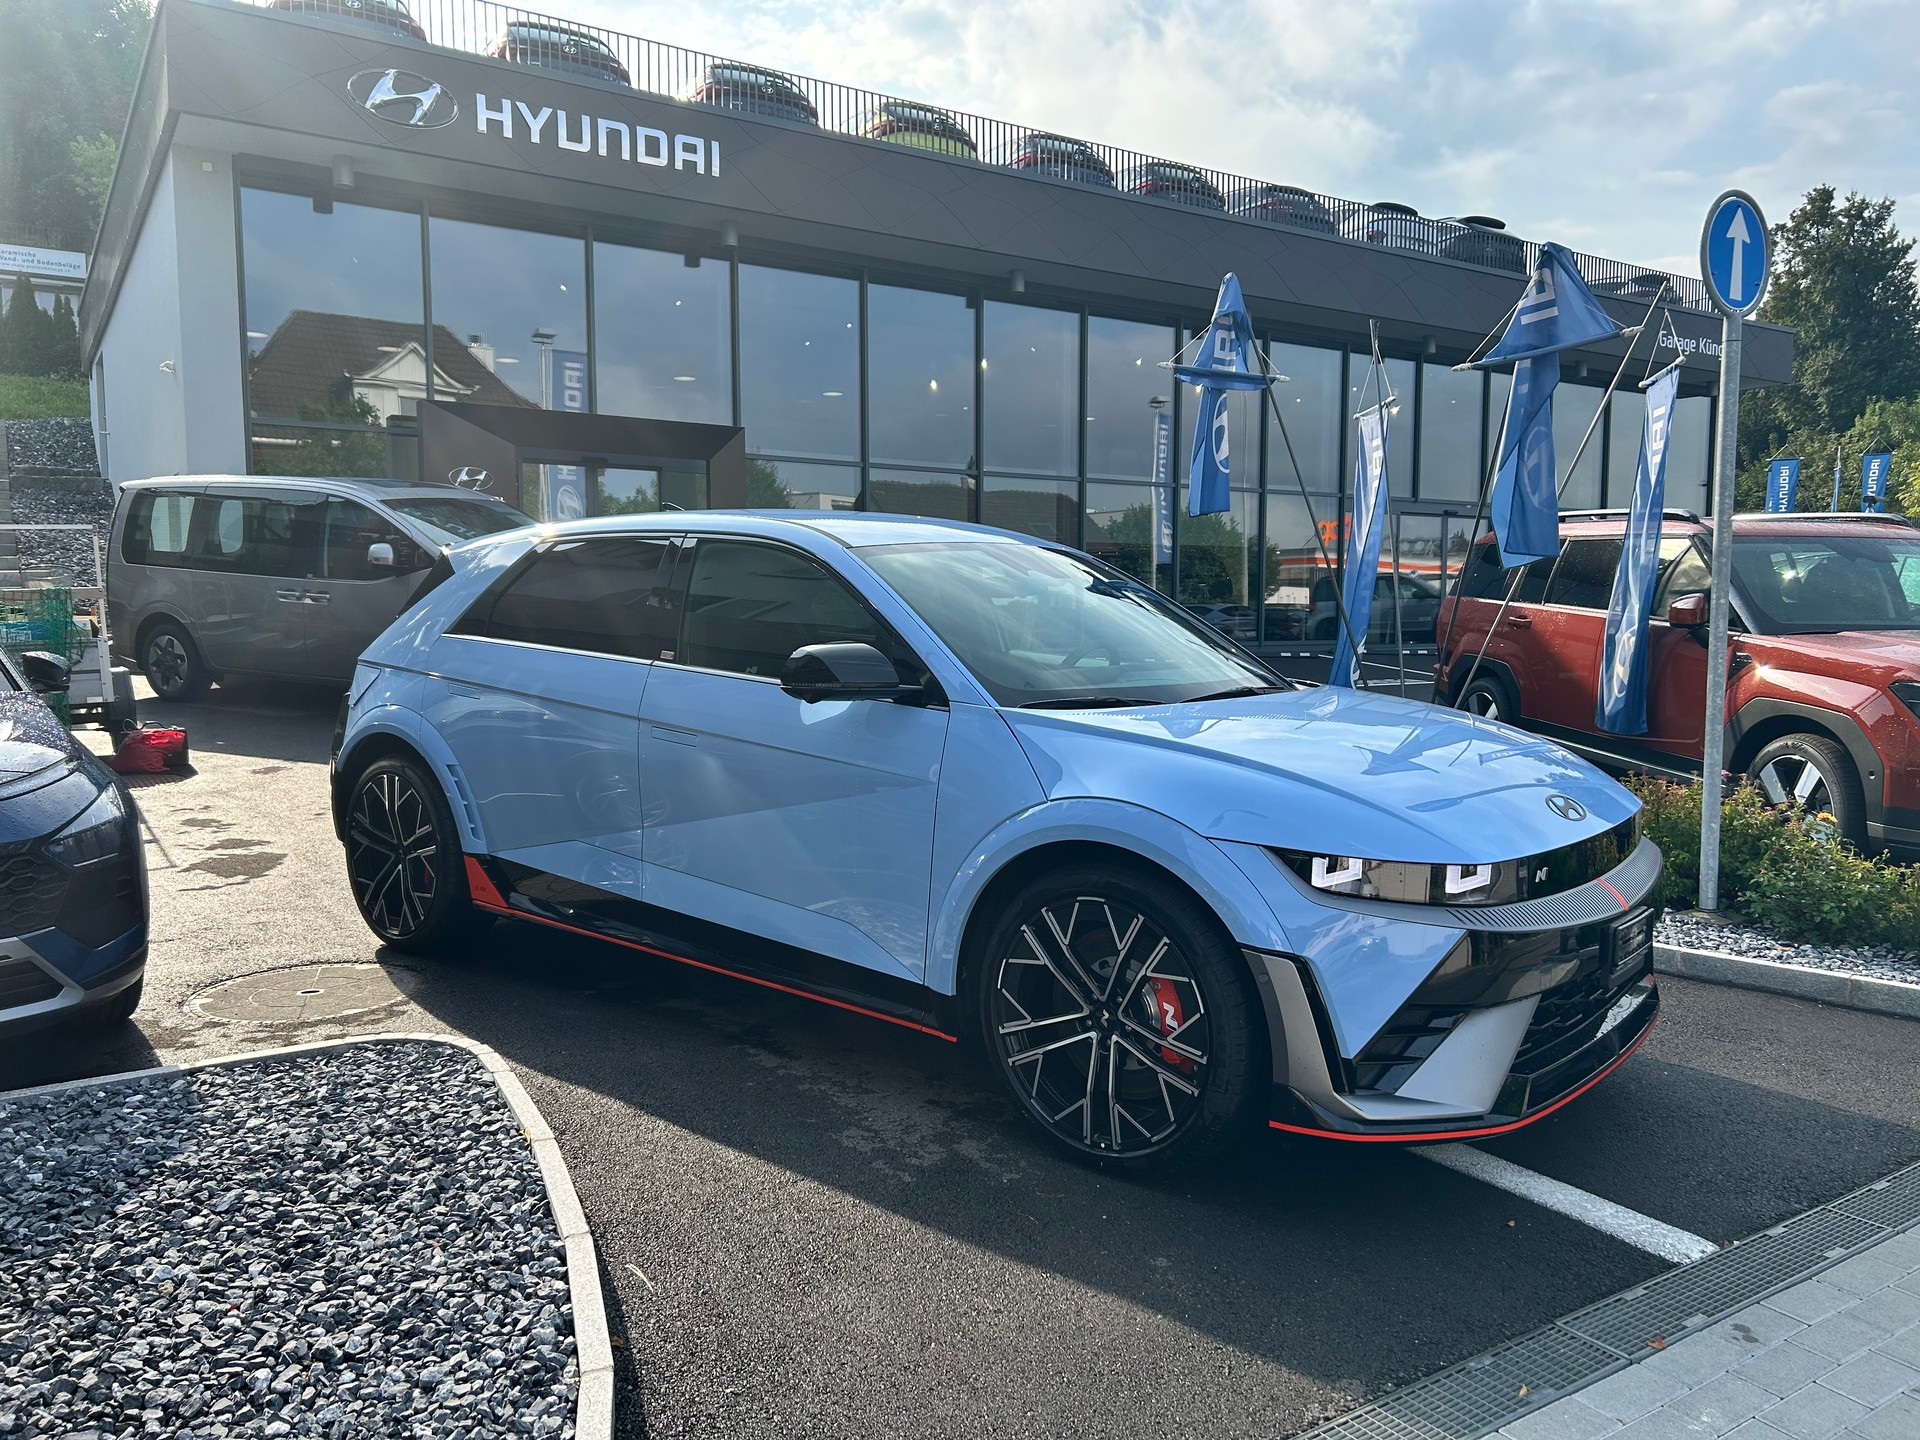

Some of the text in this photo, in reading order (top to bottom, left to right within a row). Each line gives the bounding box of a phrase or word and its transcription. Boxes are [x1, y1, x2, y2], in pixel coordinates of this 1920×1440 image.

[475, 93, 720, 178] HYUNDAI
[0, 248, 36, 257] eramische
[37, 259, 81, 270] Bodenbeläge
[1659, 331, 1696, 355] Garage
